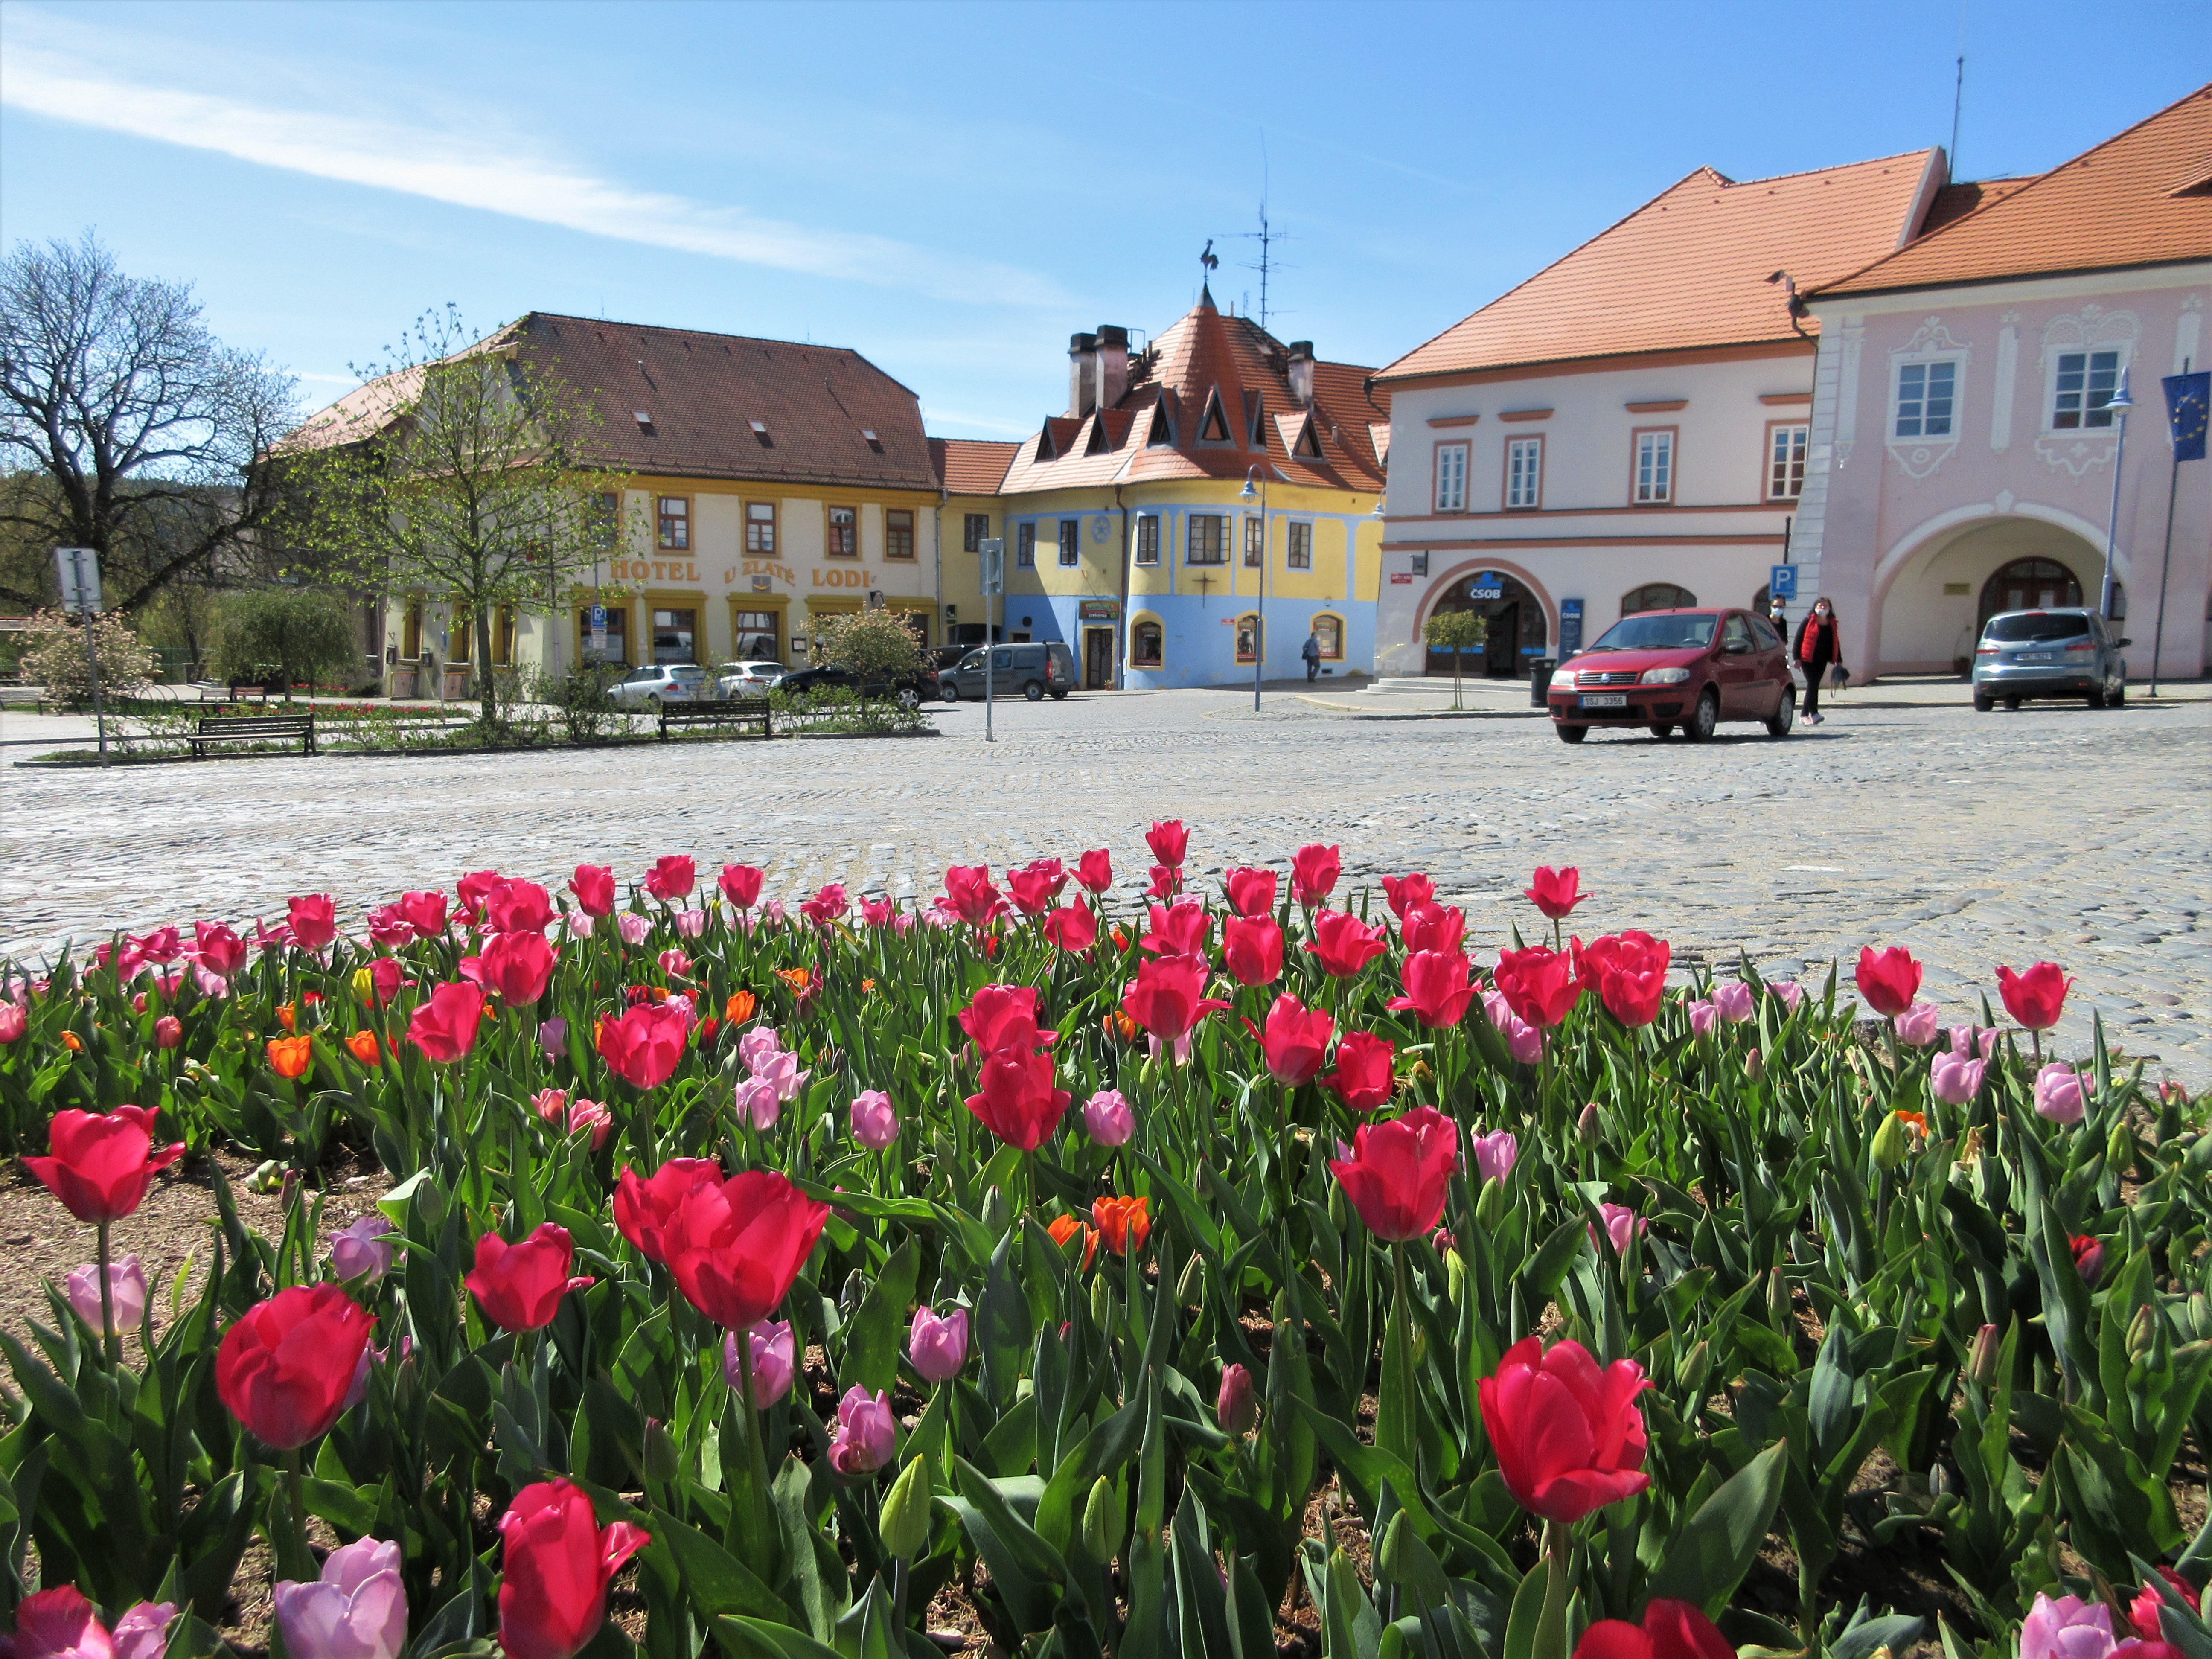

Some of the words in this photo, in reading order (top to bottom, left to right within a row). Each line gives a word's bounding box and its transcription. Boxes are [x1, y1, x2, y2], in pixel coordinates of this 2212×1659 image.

[611, 560, 701, 581] HOTEL
[724, 567, 736, 584] U
[812, 569, 870, 588] LODI
[1776, 569, 1791, 589] P
[1470, 588, 1501, 599] ČSOB
